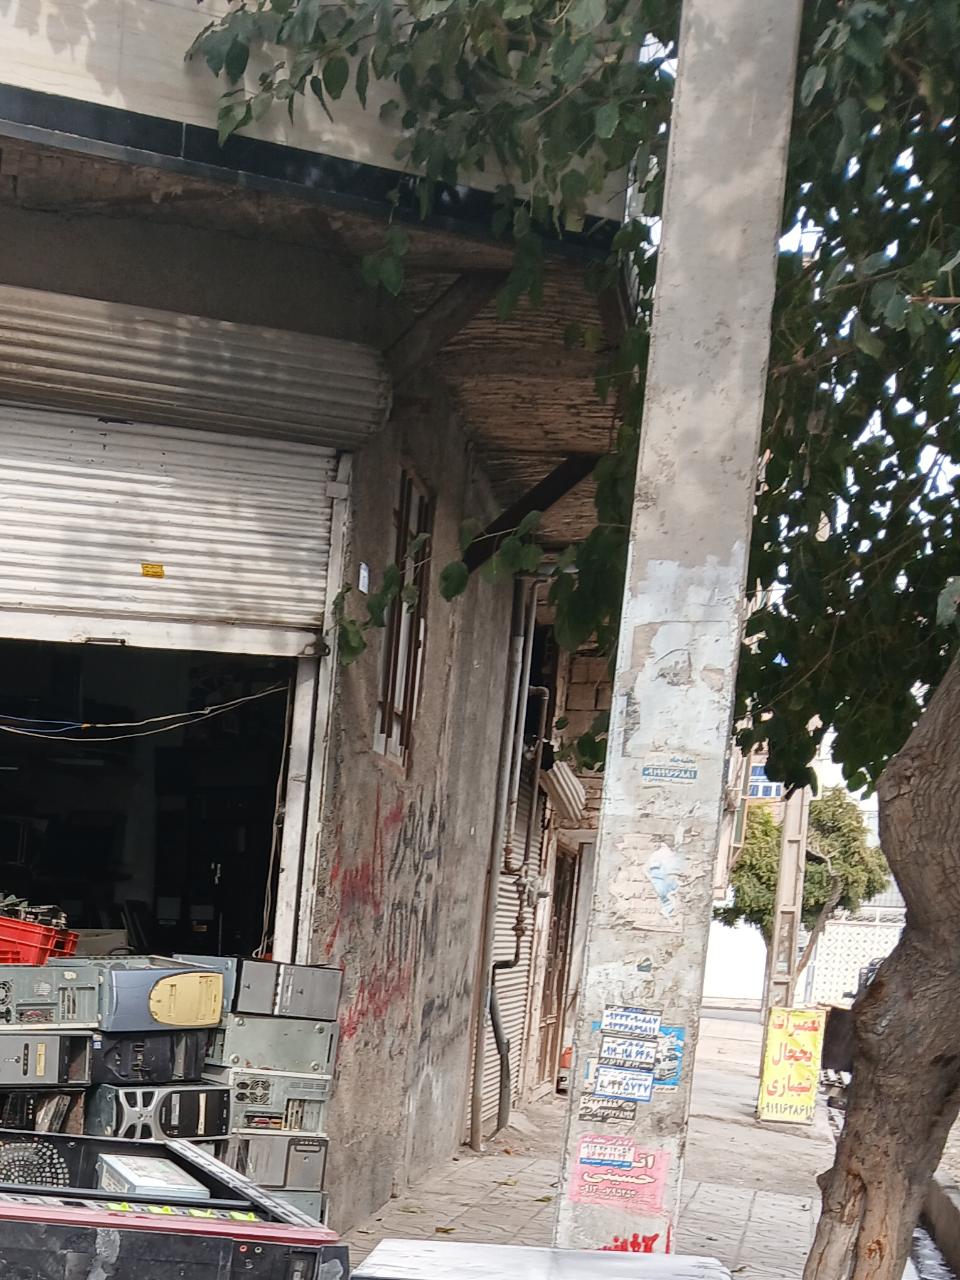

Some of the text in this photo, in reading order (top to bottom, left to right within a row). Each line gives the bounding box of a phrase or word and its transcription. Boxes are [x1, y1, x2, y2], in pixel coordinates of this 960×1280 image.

[772, 1013, 822, 1036] تعمیرات
[772, 1042, 813, 1068] یخچال
[583, 1168, 656, 1185] حسینی
